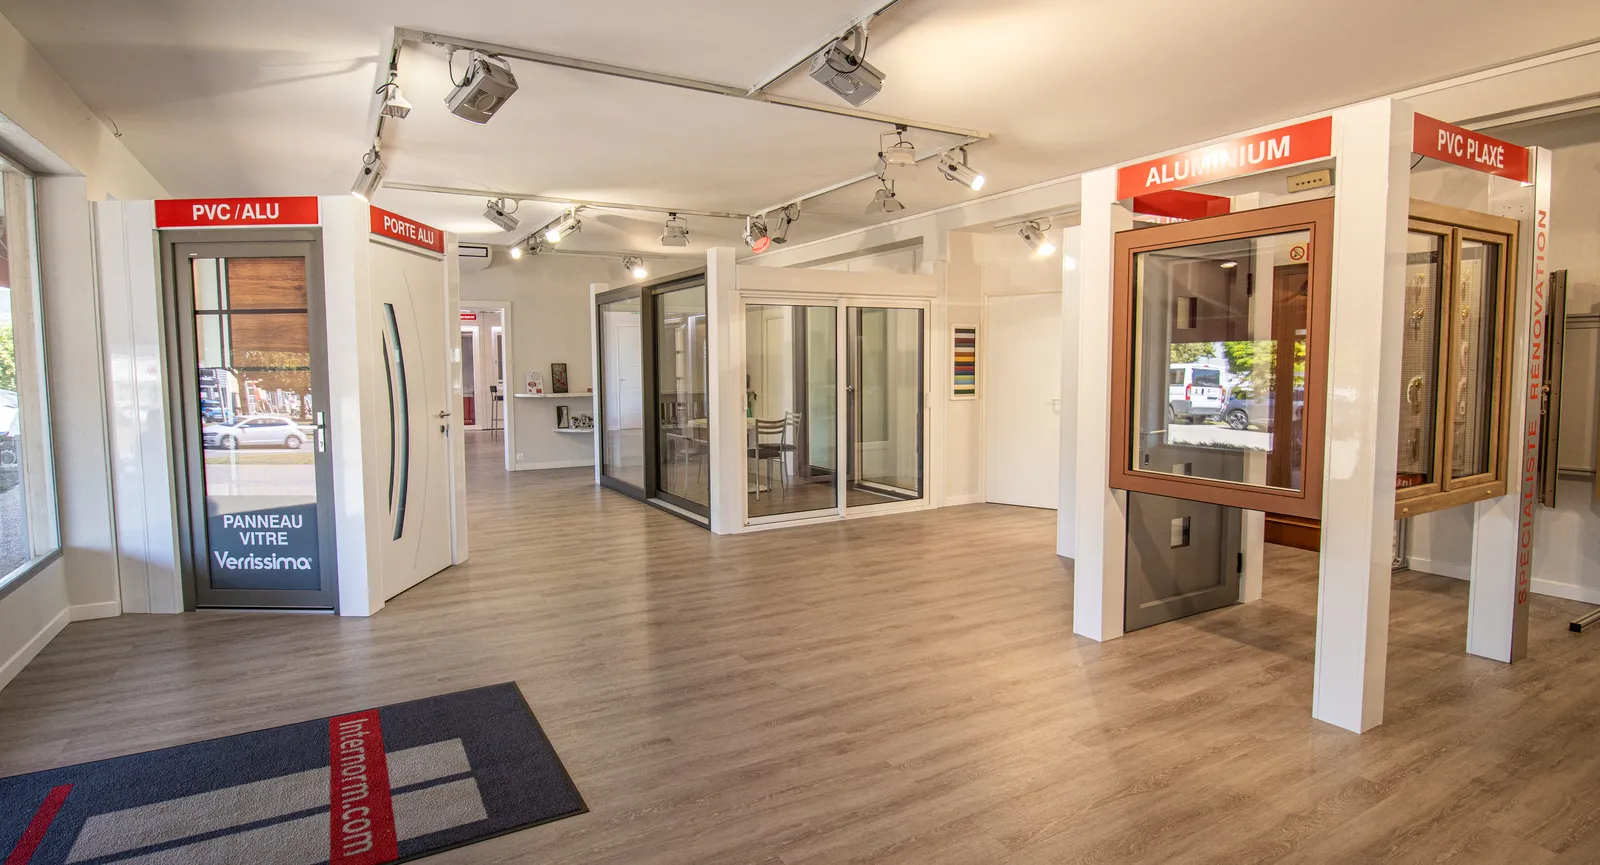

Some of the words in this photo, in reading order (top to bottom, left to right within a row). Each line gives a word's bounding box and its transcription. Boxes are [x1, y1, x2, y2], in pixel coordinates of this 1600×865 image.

[1145, 135, 1291, 187] ALUMINIUM
[1437, 128, 1464, 157] PVC
[1467, 138, 1504, 169] PLAXÉ
[192, 203, 231, 221] PVC
[383, 215, 417, 240] PORTE
[417, 227, 434, 245] ALU
[223, 514, 303, 529] PANNEAU
[239, 531, 289, 546] VITRE
[213, 550, 312, 570] Verrissima
[339, 718, 373, 857] Internorm.com
